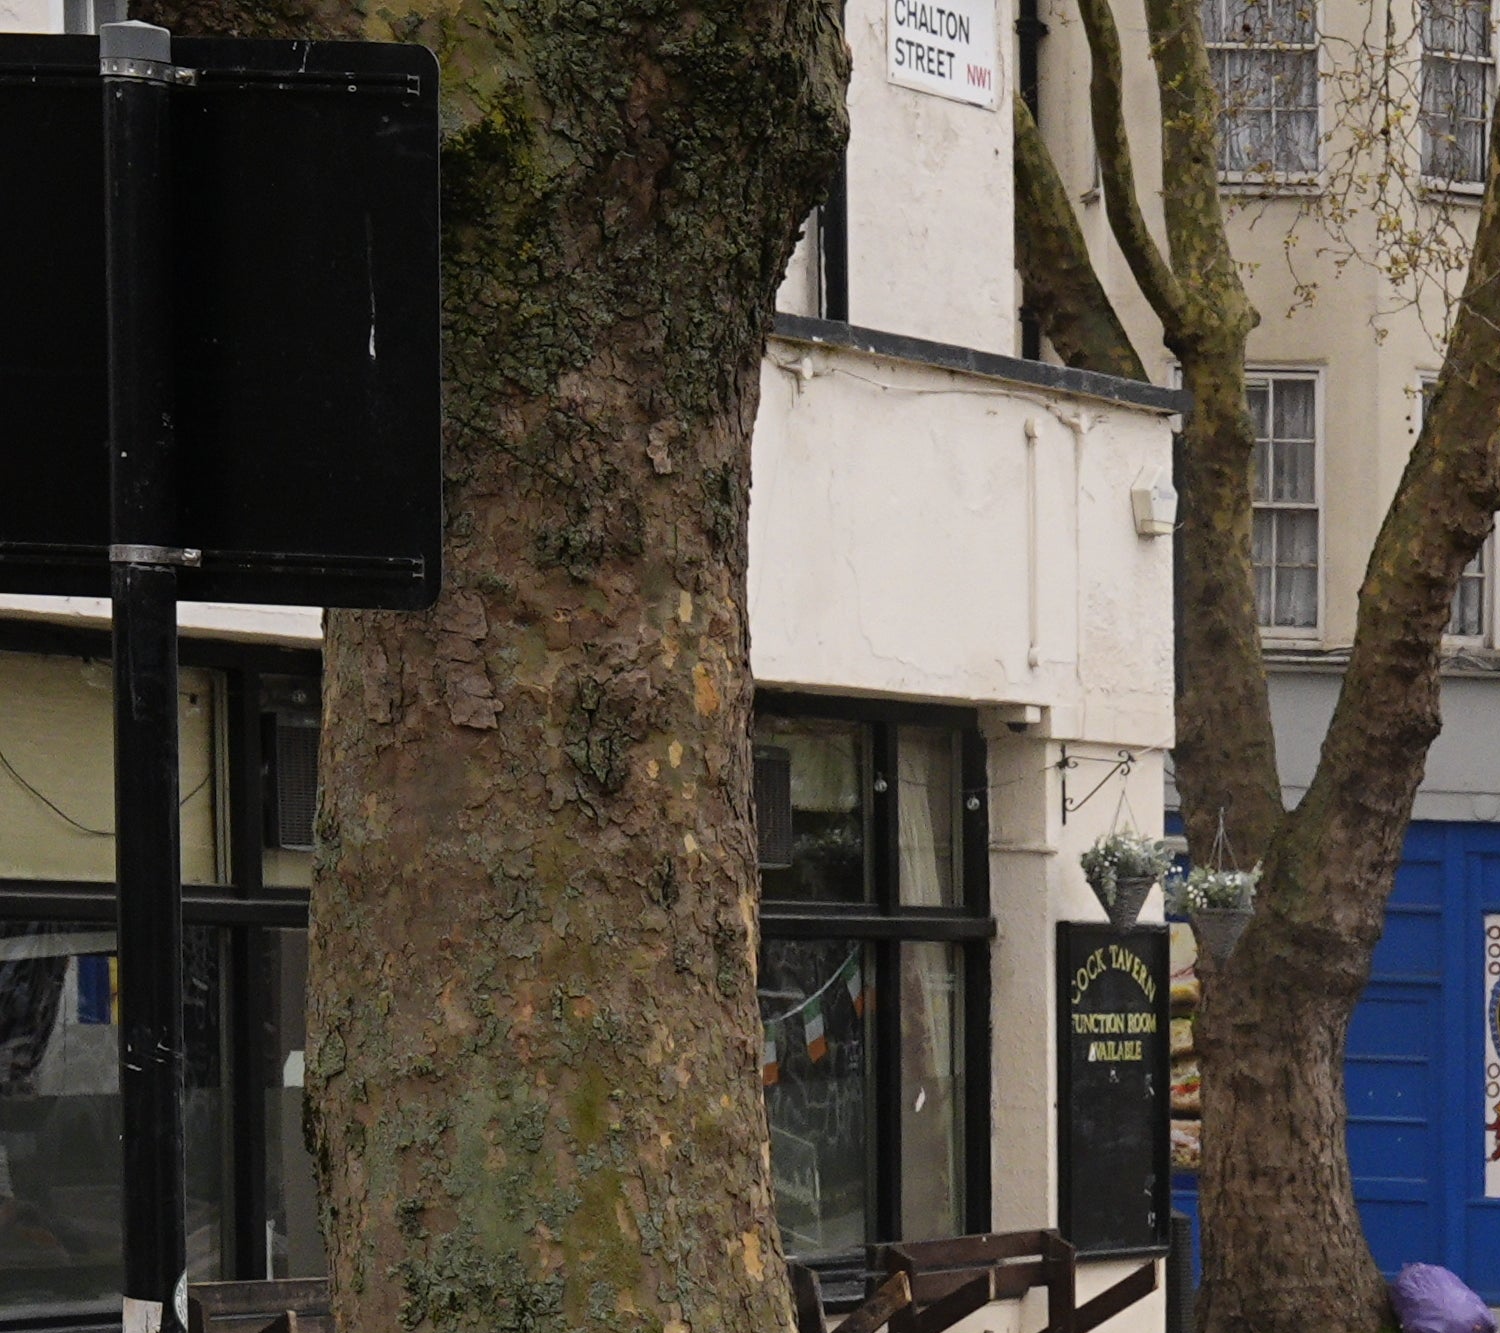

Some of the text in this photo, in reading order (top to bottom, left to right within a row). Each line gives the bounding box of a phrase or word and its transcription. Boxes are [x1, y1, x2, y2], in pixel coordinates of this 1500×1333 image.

[894, 0, 970, 45] CHALTON
[894, 37, 992, 91] STREET NW1
[1109, 945, 1157, 1003] TAVERN
[1127, 1013, 1157, 1033] ROOM
